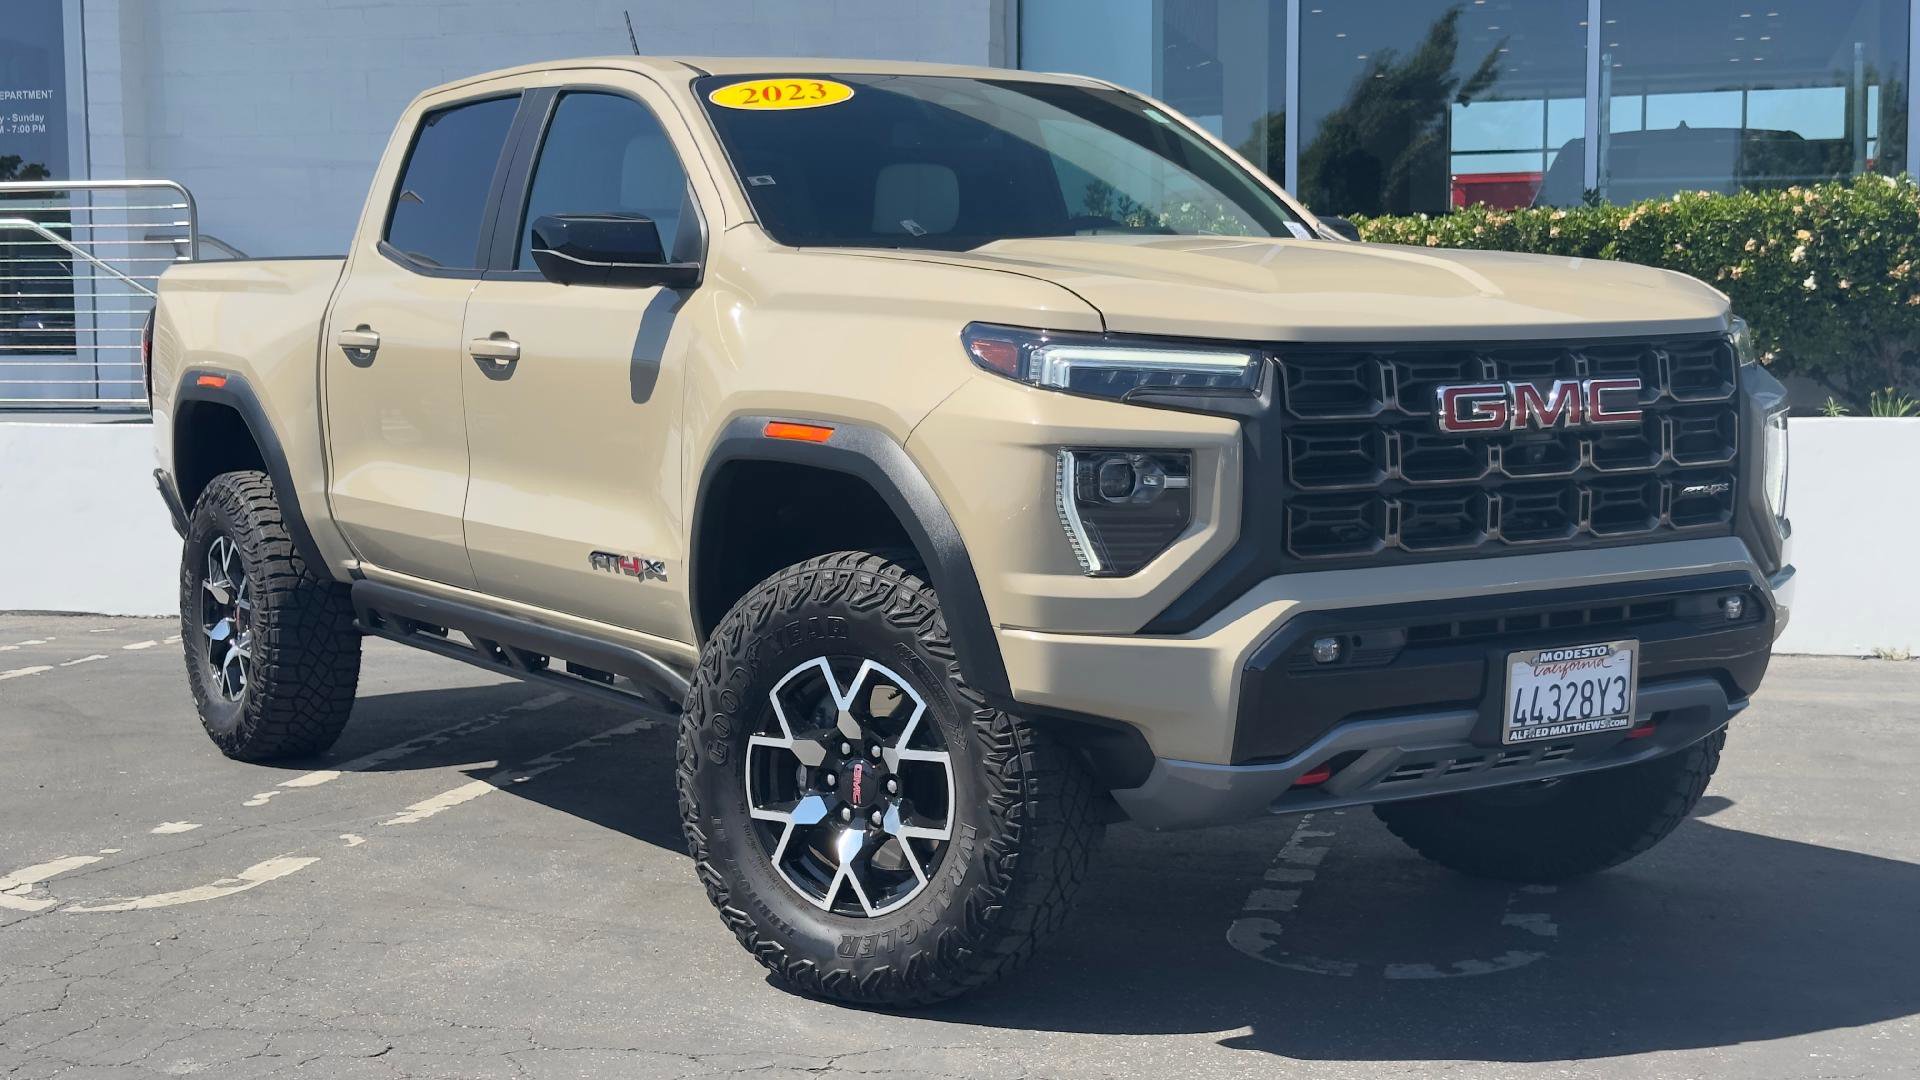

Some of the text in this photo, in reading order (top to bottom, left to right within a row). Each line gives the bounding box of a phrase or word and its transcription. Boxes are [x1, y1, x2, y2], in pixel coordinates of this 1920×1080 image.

[739, 82, 827, 105] 2023
[12, 113, 45, 123] Sunday
[12, 125, 31, 134] 7:00
[32, 124, 46, 134] PM
[1436, 378, 1643, 433] GMC
[1539, 646, 1607, 663] MODESTO
[1534, 658, 1612, 681] California
[1512, 675, 1628, 728] 44328Y3
[852, 763, 864, 805] GMC
[836, 822, 978, 960] WRANGLER
